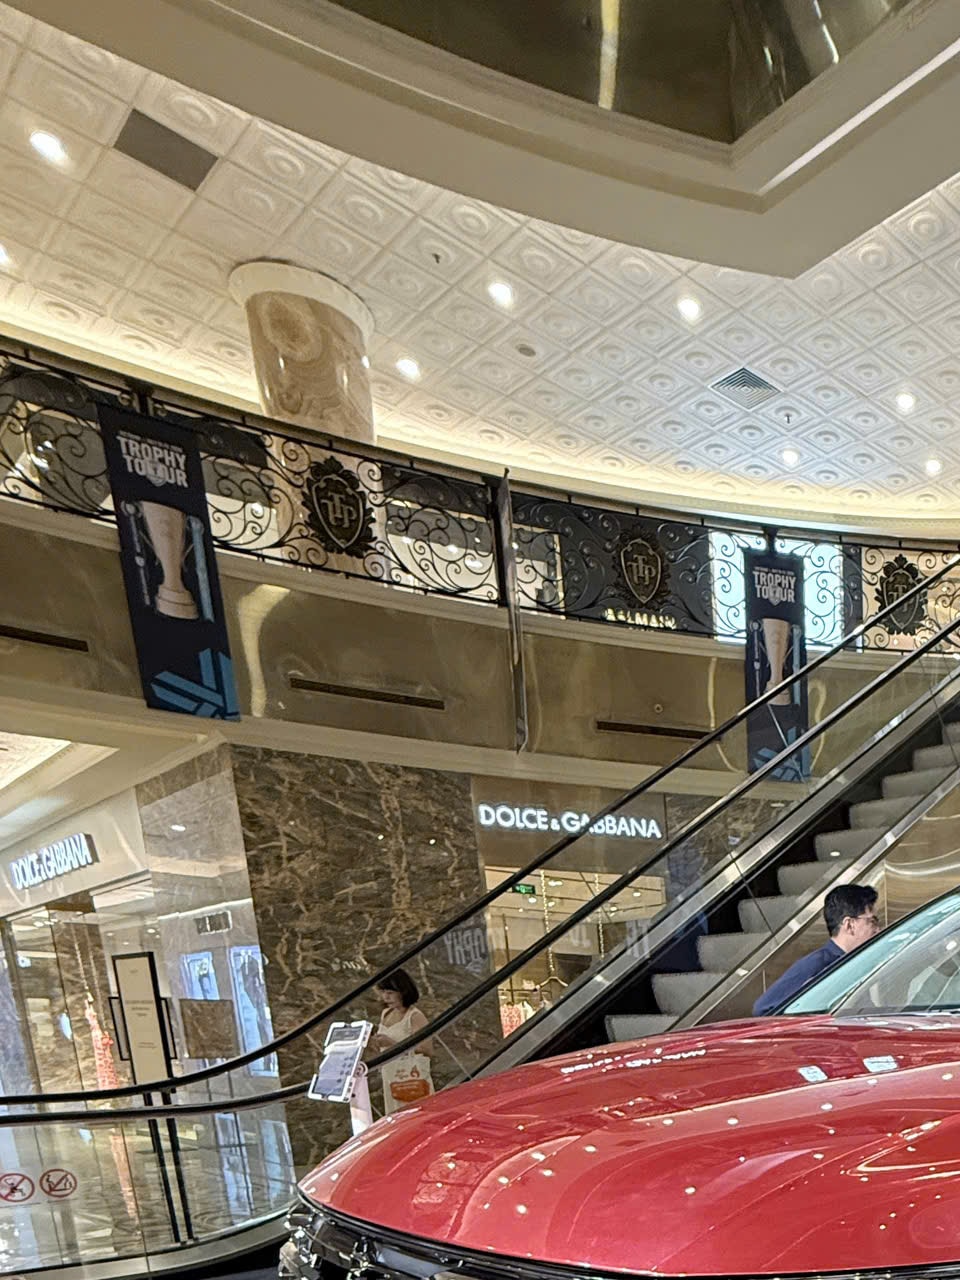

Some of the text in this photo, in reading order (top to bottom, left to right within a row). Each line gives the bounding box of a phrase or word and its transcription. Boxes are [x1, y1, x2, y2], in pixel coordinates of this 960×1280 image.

[116, 436, 187, 471] TROPHY
[122, 454, 189, 488] TOUR
[752, 570, 797, 590] TROPHY
[755, 584, 796, 603] TOUR
[478, 803, 549, 831] DOLCE
[550, 817, 561, 831] &
[10, 852, 42, 891] DOLCE
[41, 832, 93, 880] GABBANA
